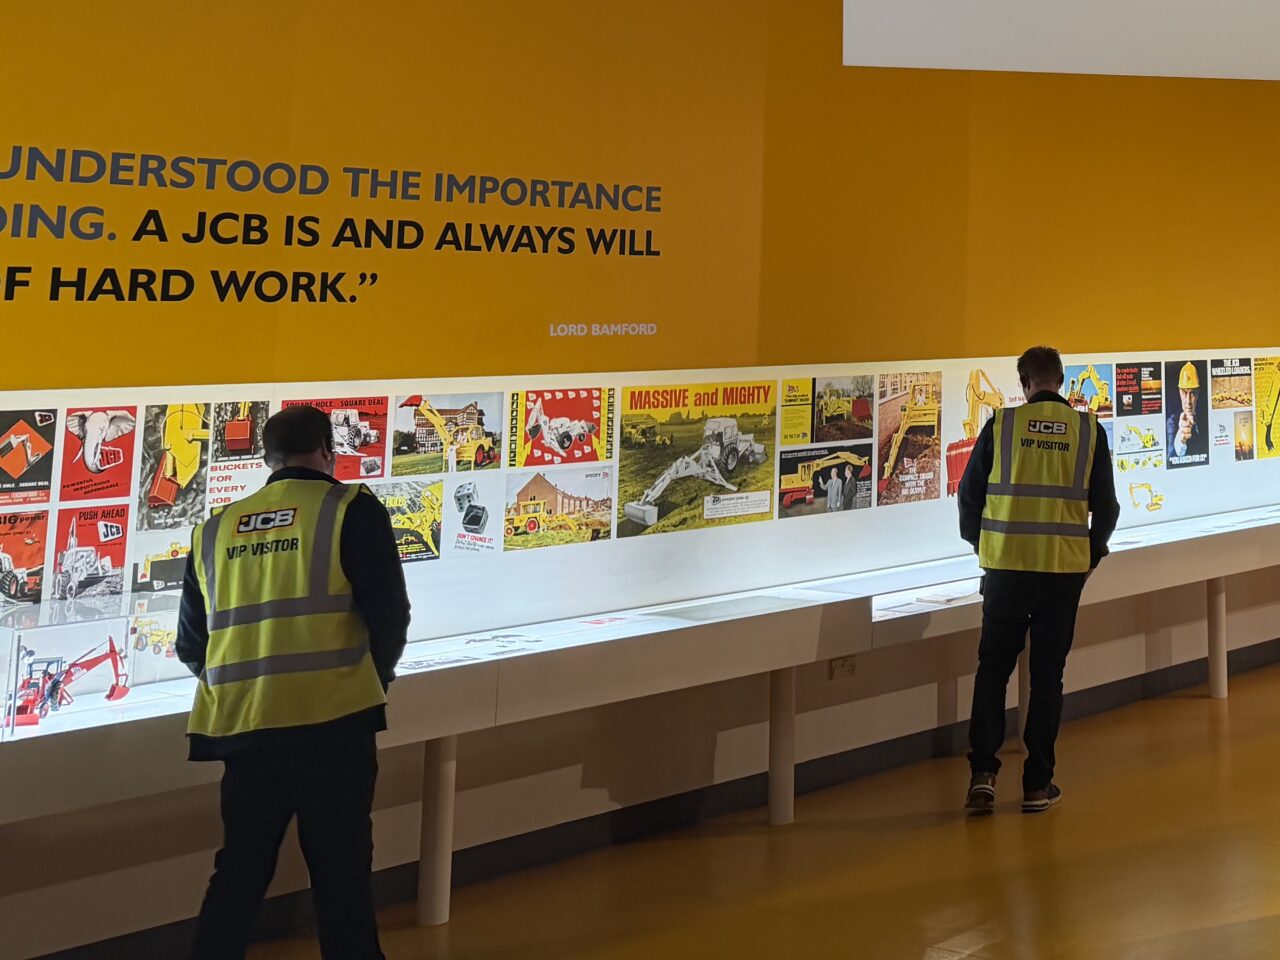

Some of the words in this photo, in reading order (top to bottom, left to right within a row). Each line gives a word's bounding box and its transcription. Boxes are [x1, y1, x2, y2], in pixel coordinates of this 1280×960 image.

[0, 145, 329, 196] UNDERSTOOD
[342, 167, 422, 200] THE
[433, 172, 662, 212] IMPORTANCE
[0, 203, 117, 241] ING.
[132, 208, 168, 242] A
[181, 211, 269, 245] JCB
[284, 215, 320, 247] IS
[332, 217, 424, 250] AND
[434, 222, 576, 254] ALWAYS
[585, 227, 661, 256] WILL
[0, 266, 32, 301] F
[49, 267, 195, 302] HARD
[549, 324, 587, 337] LORD
[591, 324, 657, 337] BAMFORD
[630, 389, 689, 410] MASSIVE
[694, 388, 719, 407] and
[722, 386, 771, 405] MIGHTY
[1029, 421, 1066, 433] JCB
[1021, 438, 1034, 447] VIP
[1037, 440, 1069, 451] VISITOR
[210, 463, 262, 472] BUCKETS
[209, 485, 246, 494] EVERY
[79, 511, 98, 520] PUSH
[101, 508, 125, 518] AHEAD
[238, 511, 296, 532] JCB
[103, 523, 120, 538] JCB
[226, 545, 247, 559] VIP
[252, 538, 299, 555] VISITOR
